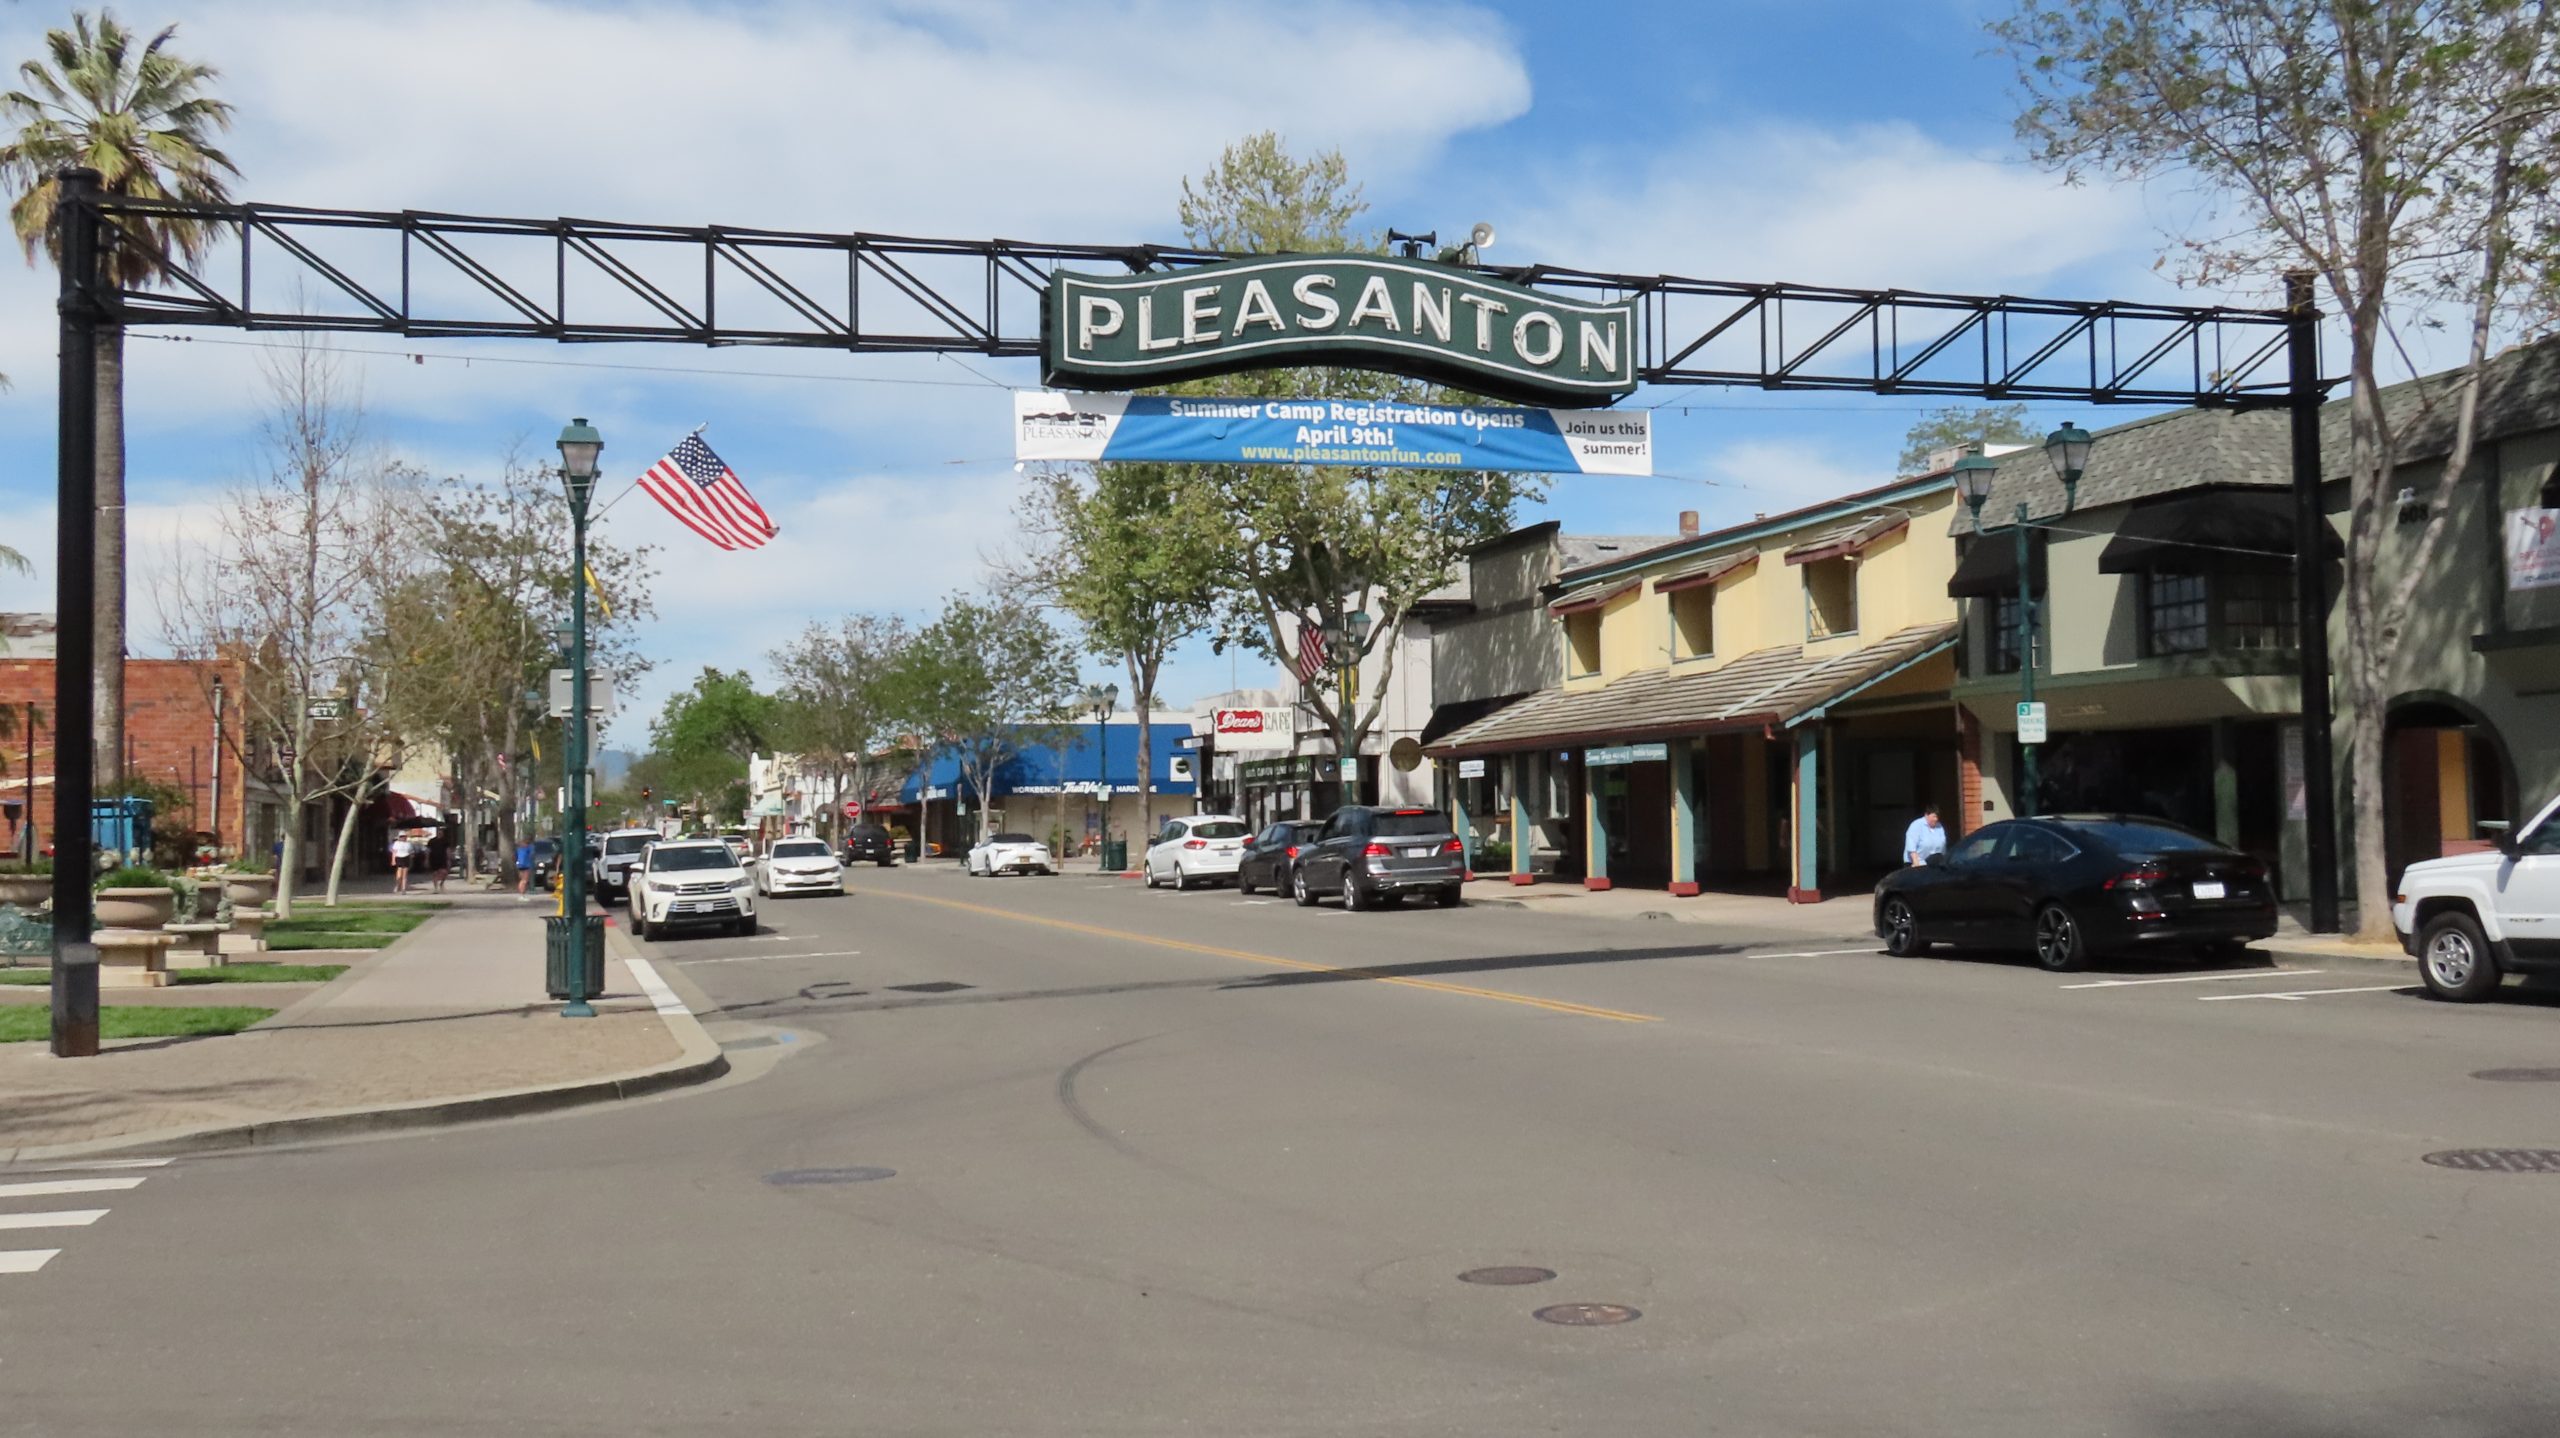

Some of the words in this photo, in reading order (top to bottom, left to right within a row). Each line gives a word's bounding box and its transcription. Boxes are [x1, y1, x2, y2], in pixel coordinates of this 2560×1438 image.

[1079, 274, 1617, 373] PLEASANTON
[1170, 400, 1261, 419] Summer
[1265, 402, 1326, 424] Camp
[1331, 403, 1456, 426] Registration
[1461, 409, 1525, 431] Opens
[1023, 426, 1108, 441] PLEASANTON
[1296, 426, 1348, 447] April
[1351, 427, 1394, 446] 9th!
[1565, 421, 1596, 434] Join
[1600, 424, 1615, 435] us
[1618, 422, 1646, 435] this
[1241, 445, 1462, 464] www.pleasantonfun.com
[1583, 443, 1646, 456] summer!
[1217, 712, 1261, 730] Dean's
[1011, 785, 1062, 794] WORKBENCH
